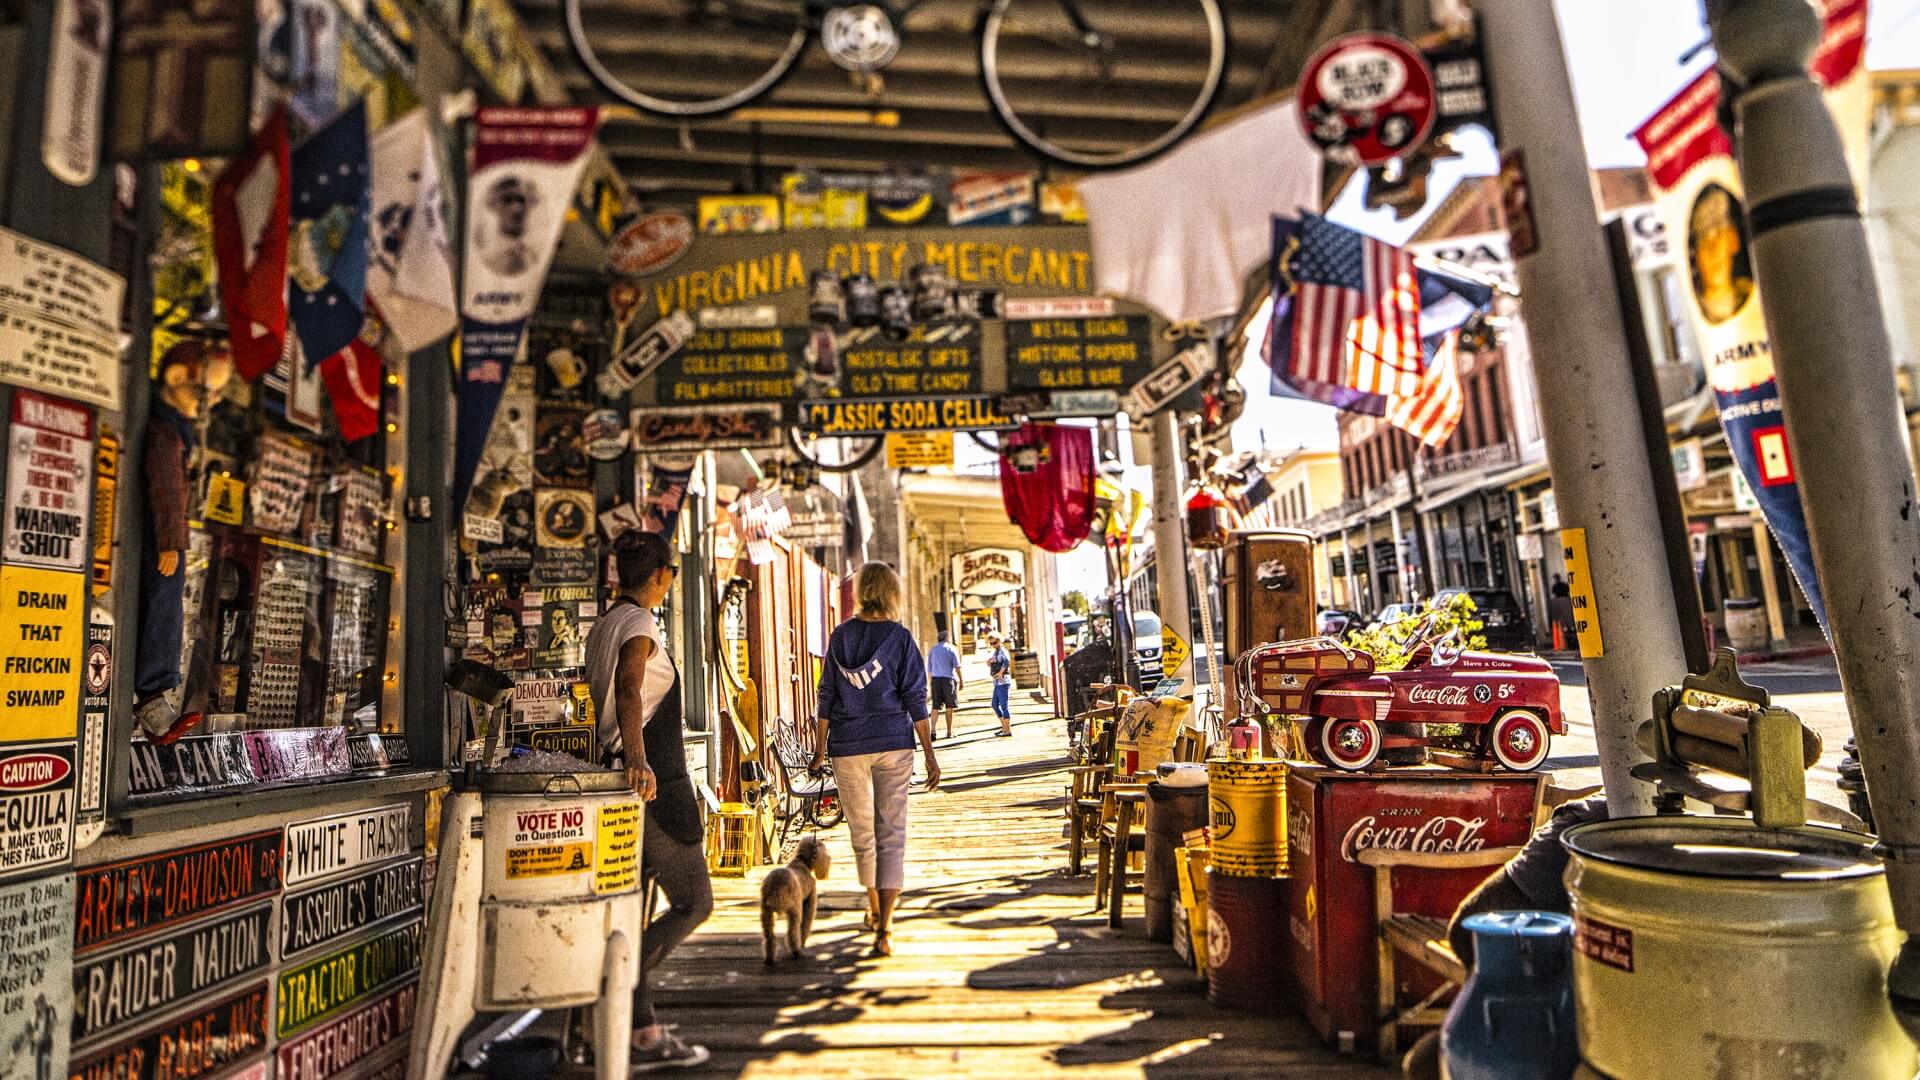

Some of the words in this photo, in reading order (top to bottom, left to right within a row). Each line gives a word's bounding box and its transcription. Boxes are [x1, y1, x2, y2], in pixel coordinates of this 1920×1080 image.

[656, 249, 806, 317] VIRGINIA
[826, 241, 907, 281] CITY
[924, 241, 1090, 290] MERCANT
[922, 372, 970, 391] CANDY
[810, 402, 886, 433] CLASSIC
[890, 401, 938, 427] SODA
[942, 399, 1009, 427] CELLA
[15, 506, 82, 537] WARNING
[20, 532, 73, 559] SHOT
[963, 552, 1010, 574] SUPER
[960, 567, 1021, 590] CHICKEN
[17, 591, 67, 610] DRAIN
[20, 623, 62, 641] THAT
[5, 657, 70, 673] FRICKIN
[6, 690, 65, 707] SWAMP
[515, 681, 561, 700] DEMOCRAT
[1408, 684, 1470, 705] Coca-Cola
[1498, 683, 1516, 699] 5¢
[536, 737, 587, 751] CAUTION
[2, 761, 53, 785] CAUTION
[129, 745, 166, 791] AN
[517, 813, 557, 831] VOTE
[562, 810, 583, 828] NO
[603, 807, 621, 815] When
[1380, 808, 1422, 816] DRINK
[8, 832, 35, 849] MAKE
[38, 828, 62, 843] YOUR
[297, 823, 347, 876] WHITE
[358, 811, 406, 861] TRASH
[515, 833, 528, 842] on
[531, 828, 576, 841] Question
[578, 827, 584, 836] 1
[614, 830, 625, 838] Had
[1341, 816, 1488, 863] Coca-Cola
[25, 847, 46, 863] FALL
[49, 841, 65, 857] OFF
[509, 848, 535, 858] DON'T
[538, 846, 563, 856] TREAD
[597, 870, 620, 878] Orange
[31, 886, 42, 904] TO
[44, 883, 63, 901] HAVE
[77, 843, 253, 944] ARLEY-DAVIDSON
[261, 849, 276, 877] DR
[605, 881, 622, 889] Glass
[33, 905, 57, 923] LOST
[294, 879, 366, 949] ASSHOLE'S
[375, 864, 417, 918] GARAGE
[0, 933, 14, 951] TO
[17, 929, 36, 948] LIVE
[39, 923, 62, 942] WITH
[7, 947, 50, 971] PSYCHO
[86, 941, 177, 1032] RAIDER
[191, 915, 260, 989] NATION
[288, 953, 356, 1025] TRACTOR
[363, 923, 421, 991] COUNTRY
[4, 995, 24, 1014] LIFE
[291, 999, 391, 1080] FIREFIGHTER'S
